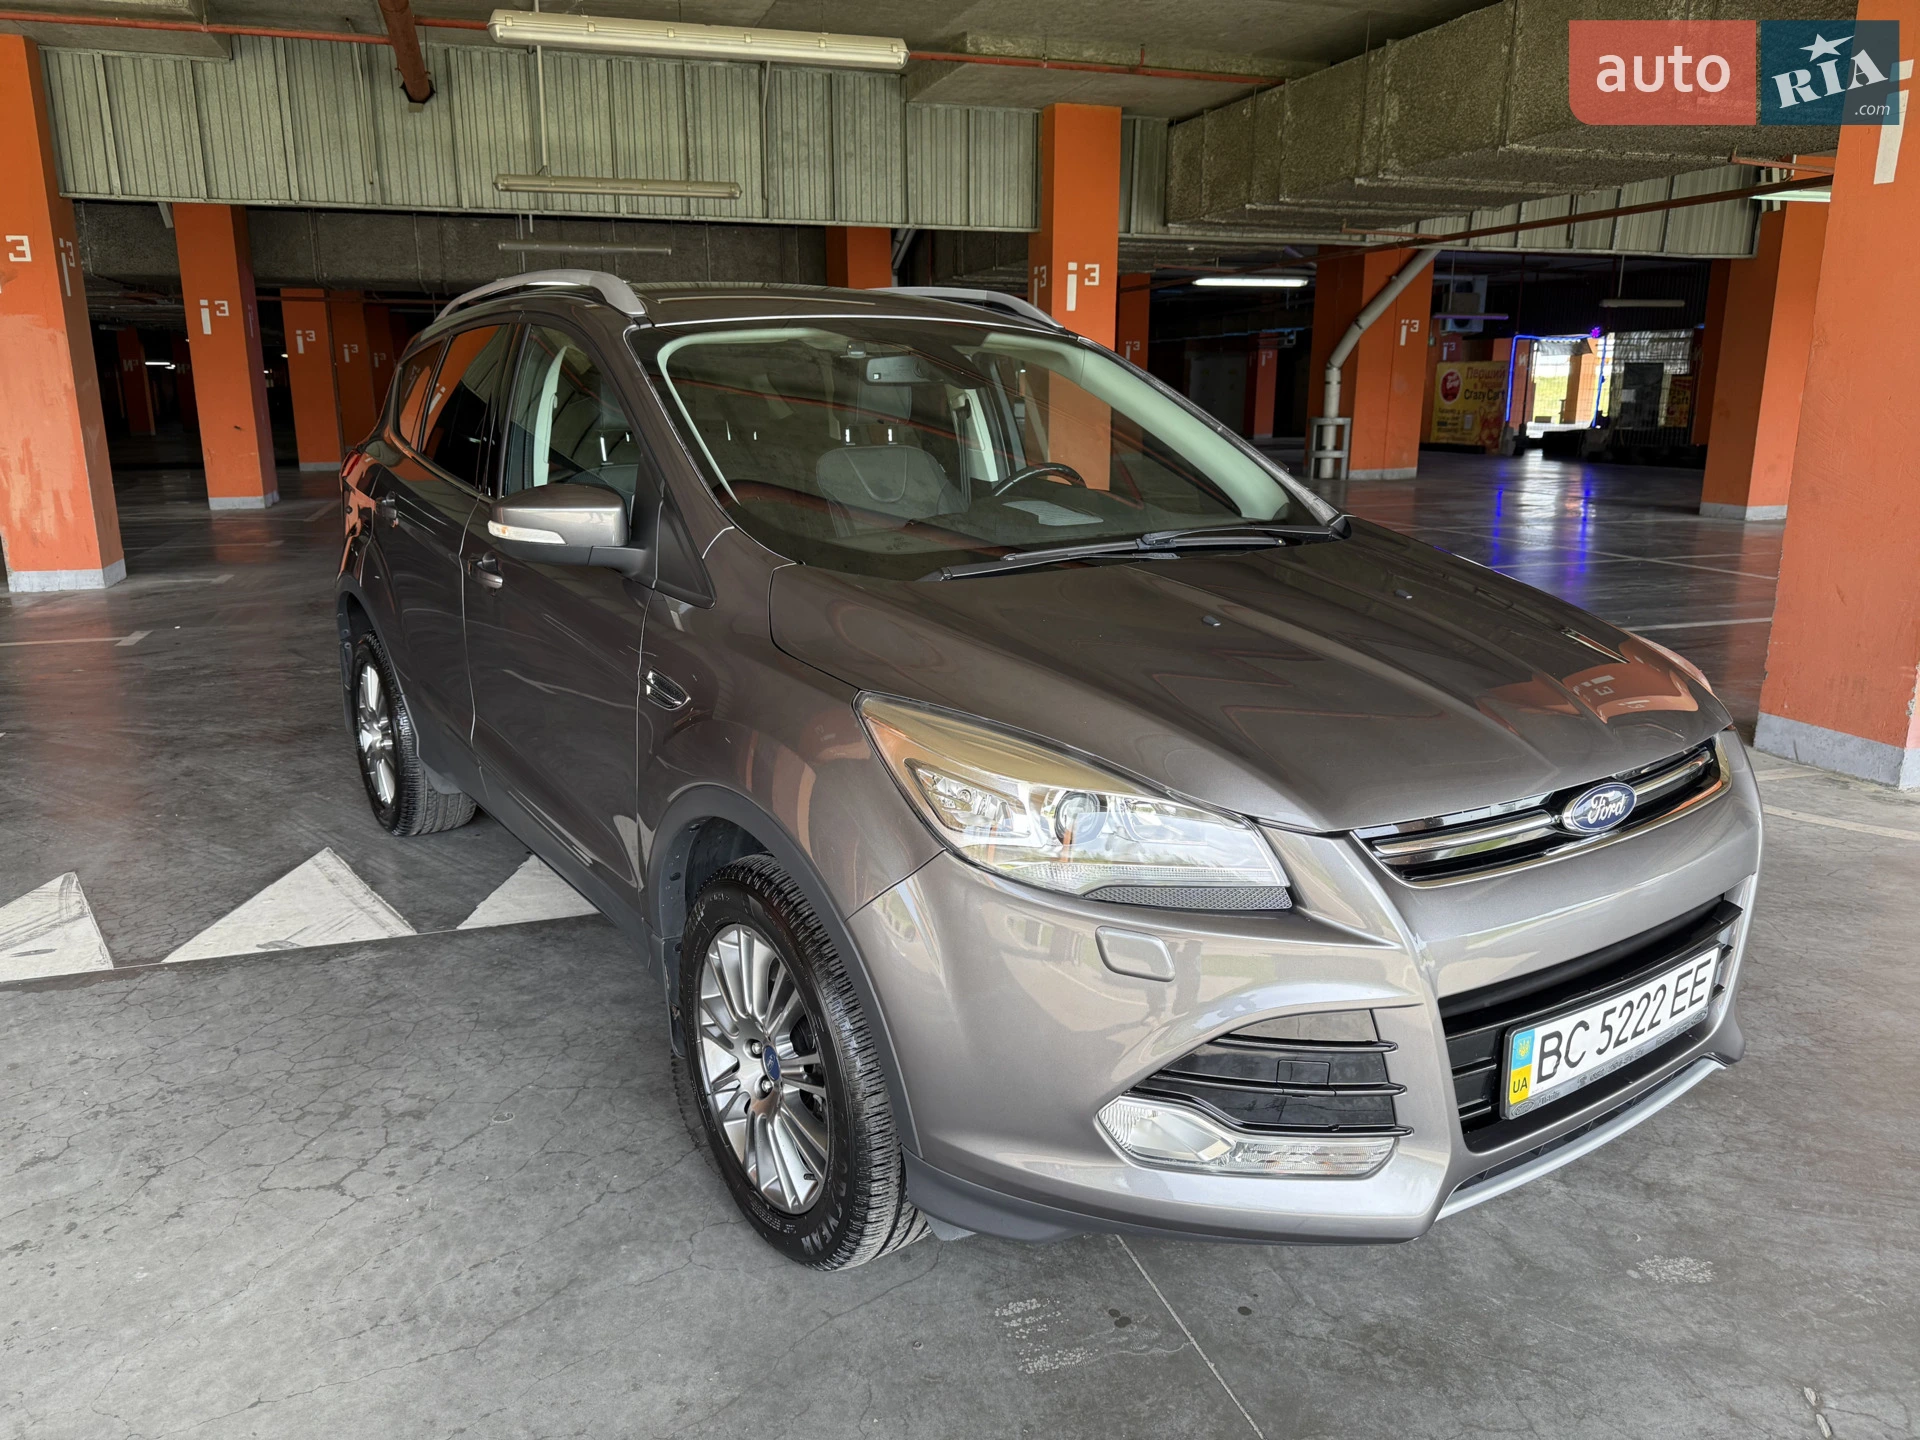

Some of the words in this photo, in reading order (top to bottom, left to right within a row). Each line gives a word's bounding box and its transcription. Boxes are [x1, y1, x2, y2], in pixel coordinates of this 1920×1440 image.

[1464, 389, 1486, 402] Crazy
[1587, 790, 1626, 825] Ford
[1536, 1020, 1590, 1085] BC
[1596, 984, 1667, 1056] 5222
[1668, 958, 1712, 1019] EE
[1512, 1077, 1528, 1093] UA
